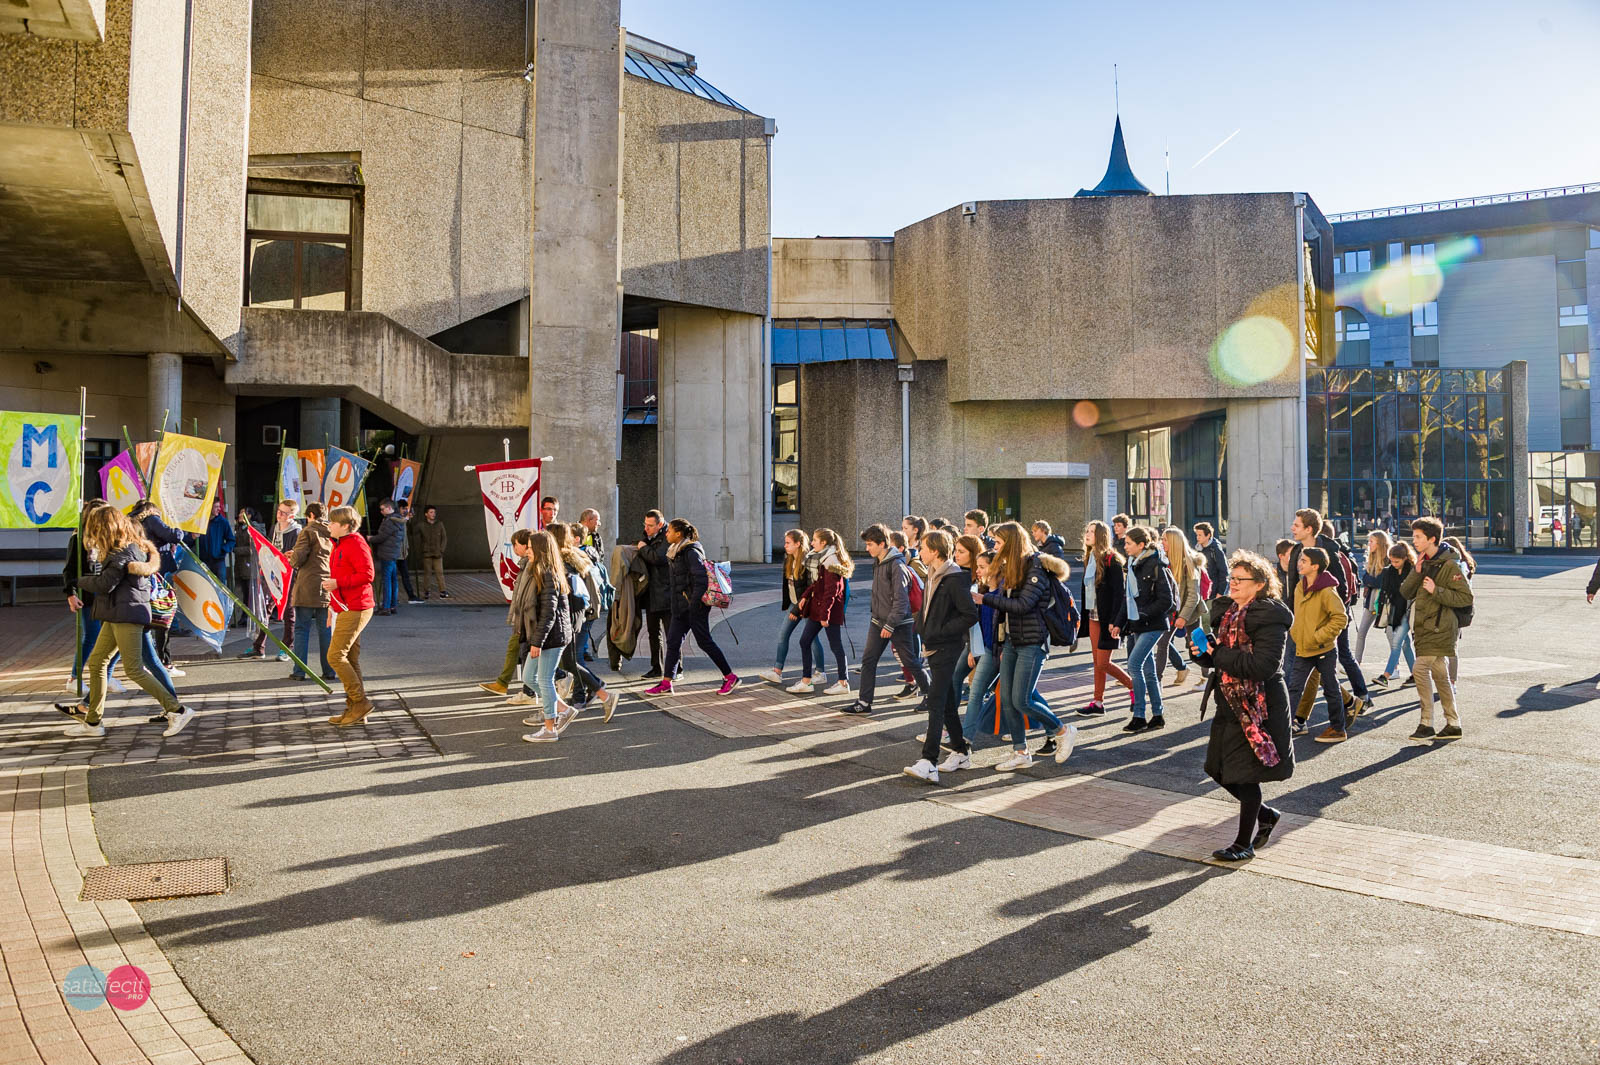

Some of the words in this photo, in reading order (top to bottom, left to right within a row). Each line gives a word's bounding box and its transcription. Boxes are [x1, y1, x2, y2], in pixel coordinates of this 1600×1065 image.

[22, 423, 58, 468] M
[108, 465, 129, 500] R
[335, 456, 353, 484] D
[501, 480, 515, 493] HB
[24, 480, 53, 525] C
[202, 600, 225, 631] O
